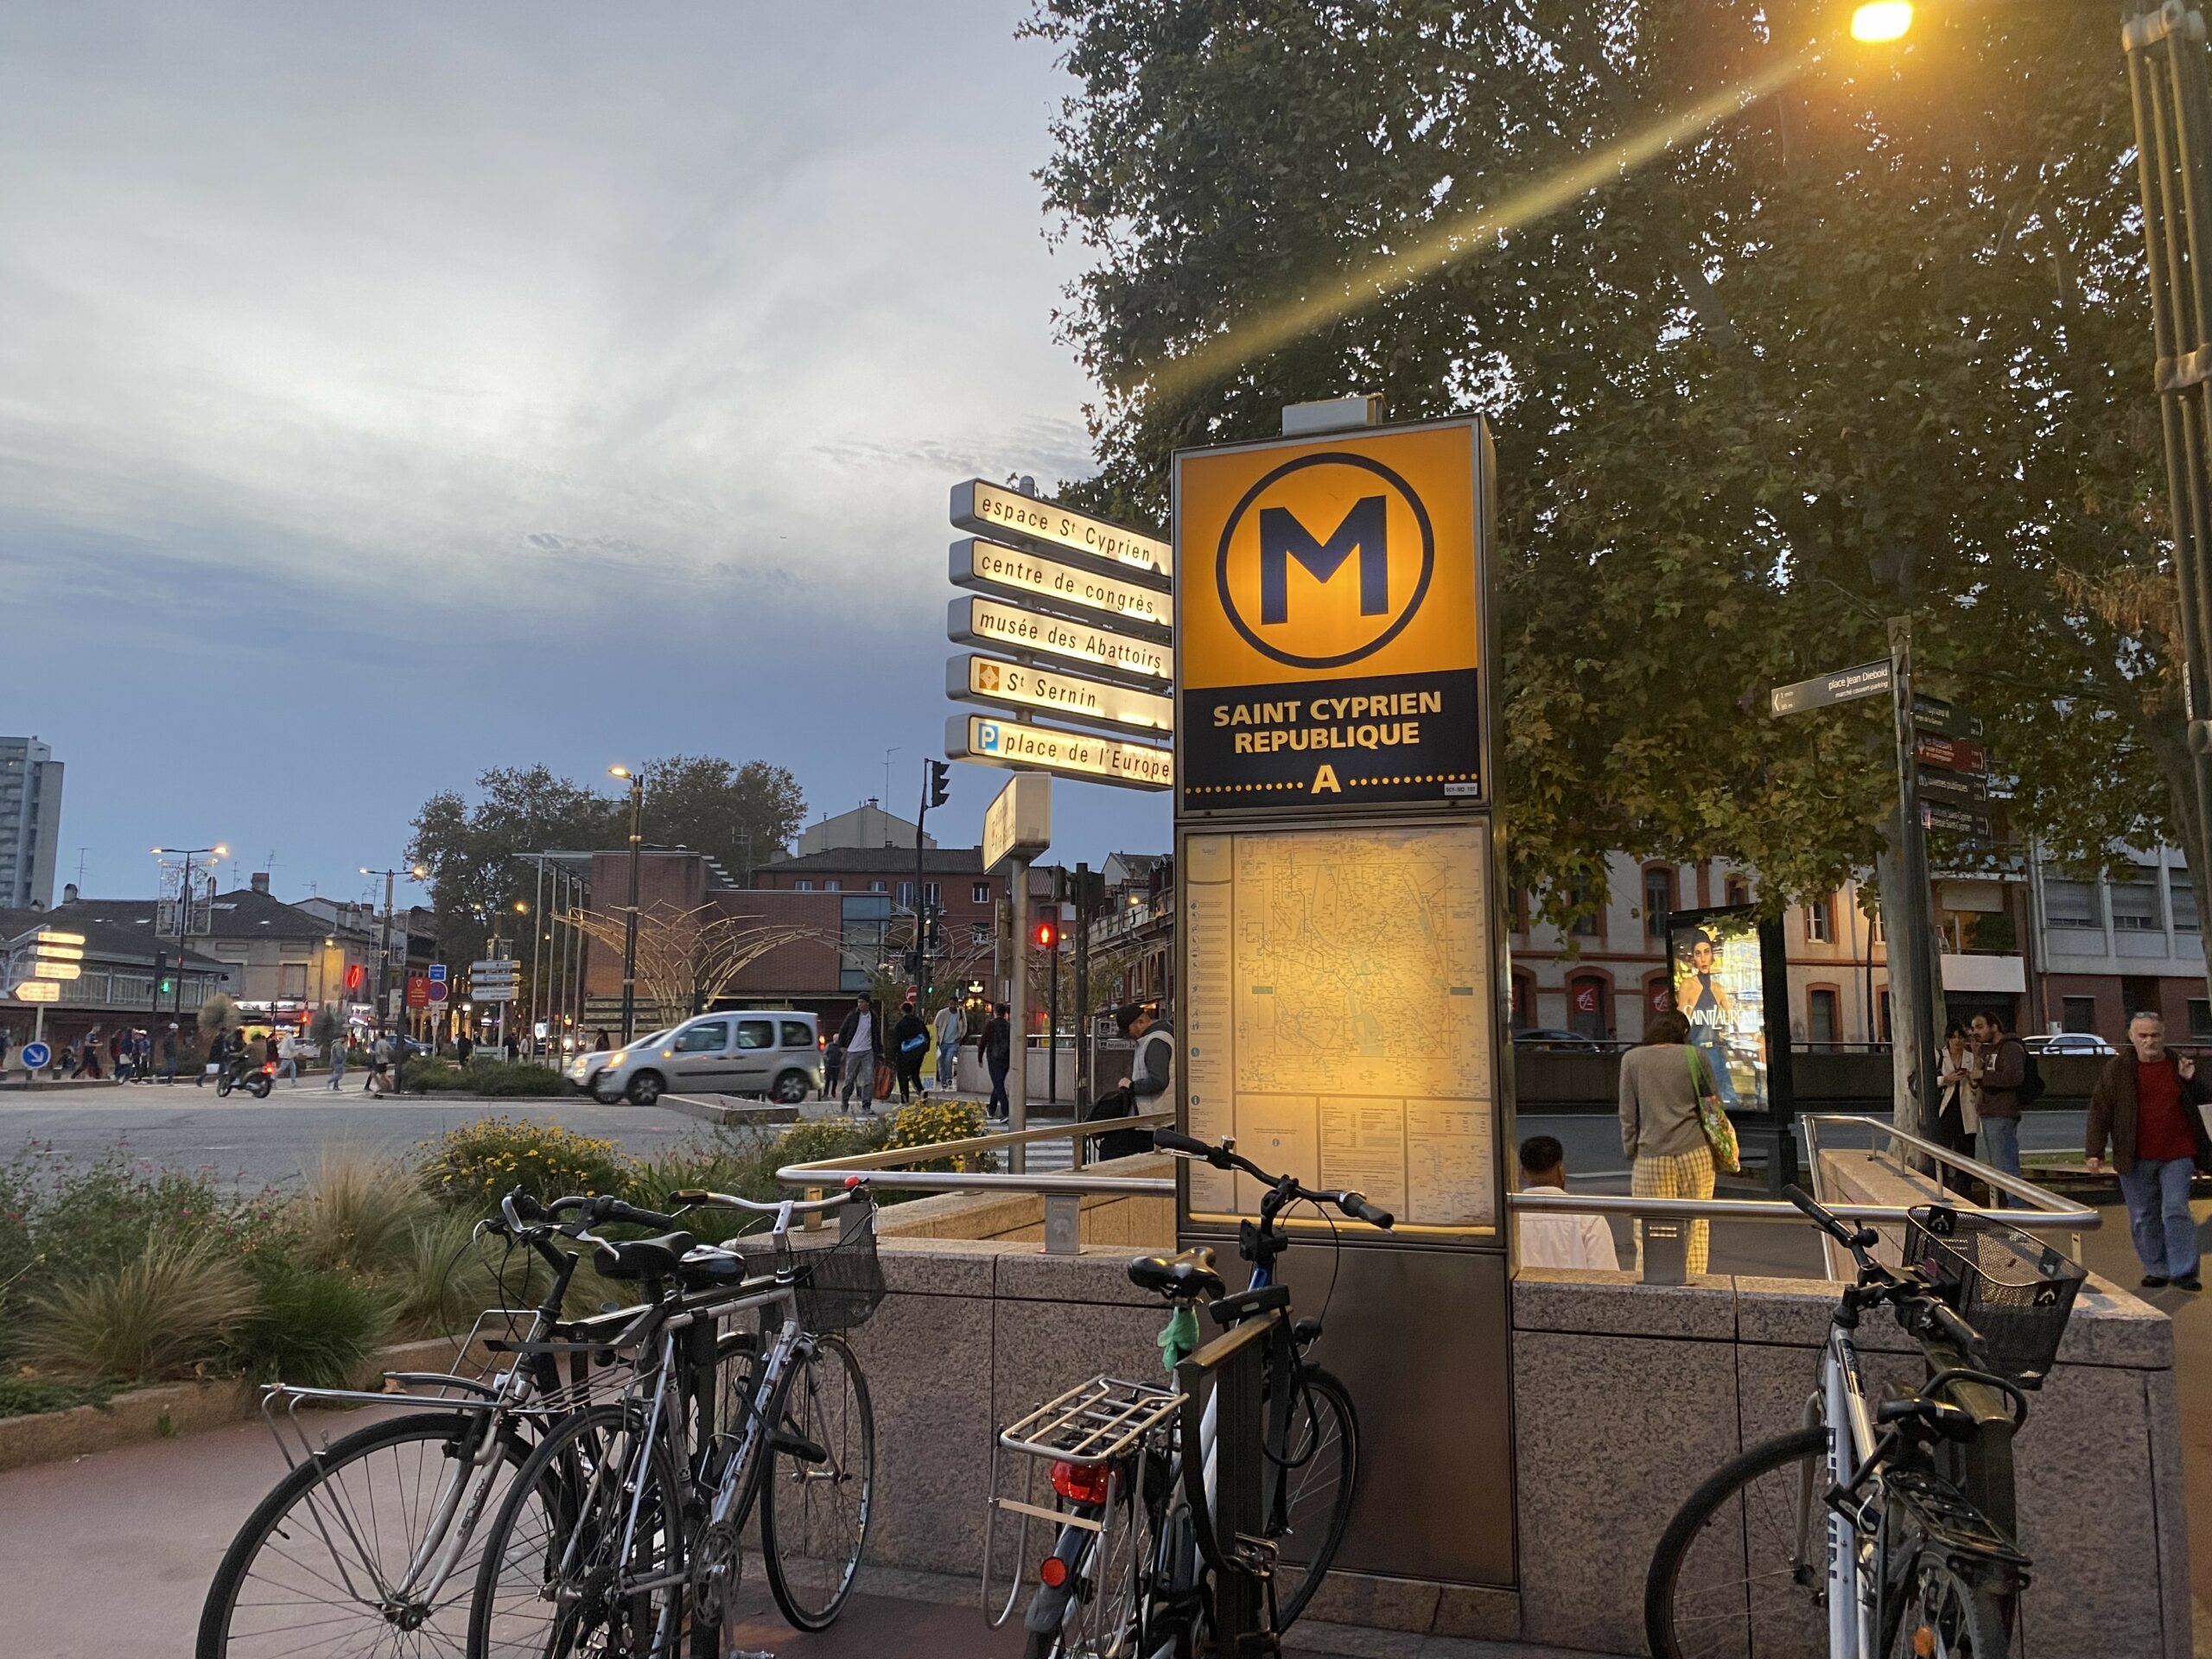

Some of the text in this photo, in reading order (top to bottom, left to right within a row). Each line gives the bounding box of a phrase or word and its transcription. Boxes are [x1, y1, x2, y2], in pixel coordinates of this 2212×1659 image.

[982, 495, 1150, 563] espace St Cyprien
[1259, 495, 1389, 626] M
[982, 555, 1154, 615] centre de congrès
[980, 611, 1161, 670] musée des Abattoirs
[1007, 672, 1096, 708] St Sernin
[1827, 667, 1888, 691] place Jean Diebold
[1212, 691, 1441, 728] SAINT CYPRIEN
[1235, 722, 1420, 753] REPUBLIQUE
[1006, 733, 1057, 758] place
[1069, 743, 1089, 763] de
[1099, 747, 1170, 780] l'Europe
[1311, 765, 1341, 794] A
[1682, 1004, 1758, 1030] SAINT LAURENT
